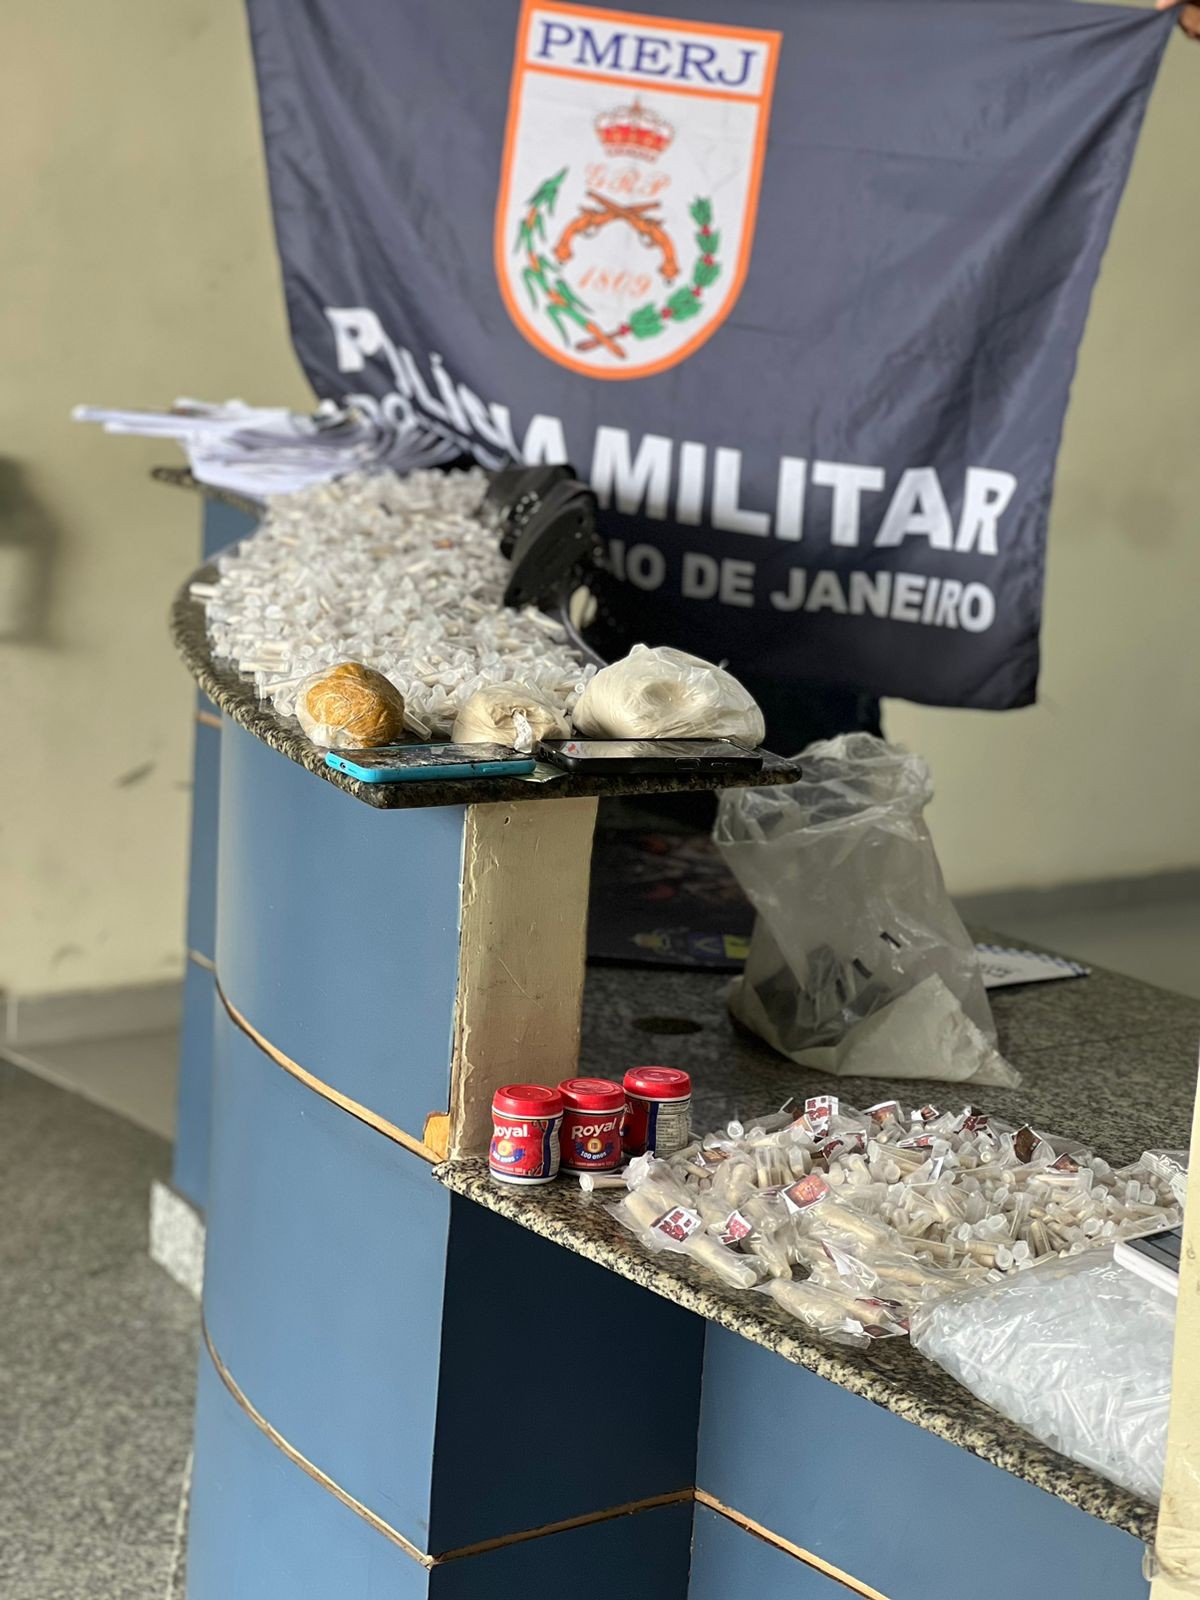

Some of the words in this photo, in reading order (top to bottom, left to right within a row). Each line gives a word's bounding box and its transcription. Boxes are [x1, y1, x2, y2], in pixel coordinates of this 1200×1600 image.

[535, 20, 758, 87] PMERJ
[590, 425, 1017, 556] MILITAR
[606, 538, 667, 592] IO
[681, 552, 756, 606] DE
[770, 568, 996, 633] JANEIRO
[571, 1117, 617, 1140] Royal
